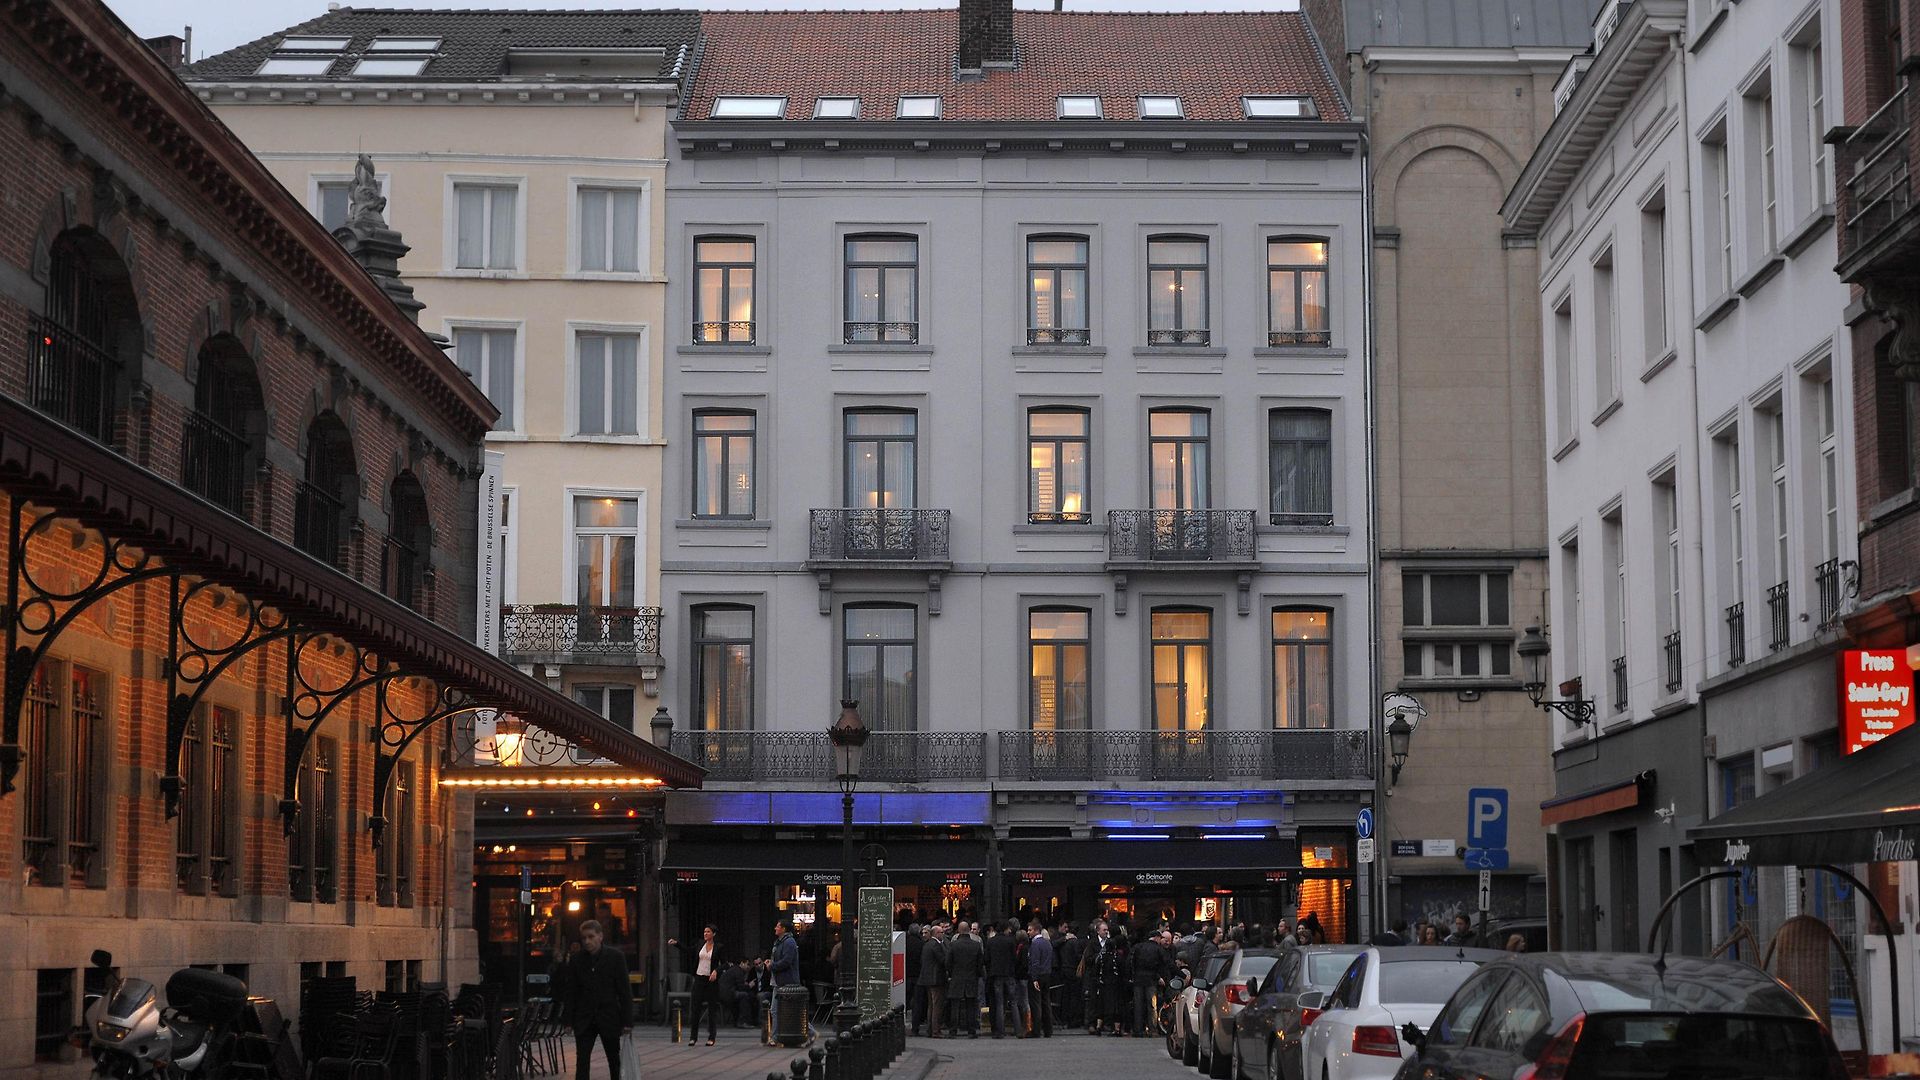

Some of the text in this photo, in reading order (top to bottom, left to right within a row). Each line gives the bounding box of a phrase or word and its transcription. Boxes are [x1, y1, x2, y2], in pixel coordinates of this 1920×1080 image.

[486, 541, 493, 549] DE
[1861, 651, 1894, 671] Press
[1473, 797, 1502, 839] P
[1724, 840, 1750, 866] Jupiler
[1873, 829, 1915, 861] Pardus
[803, 873, 841, 881] de Belmonte
[1145, 873, 1173, 881] Belmonte
